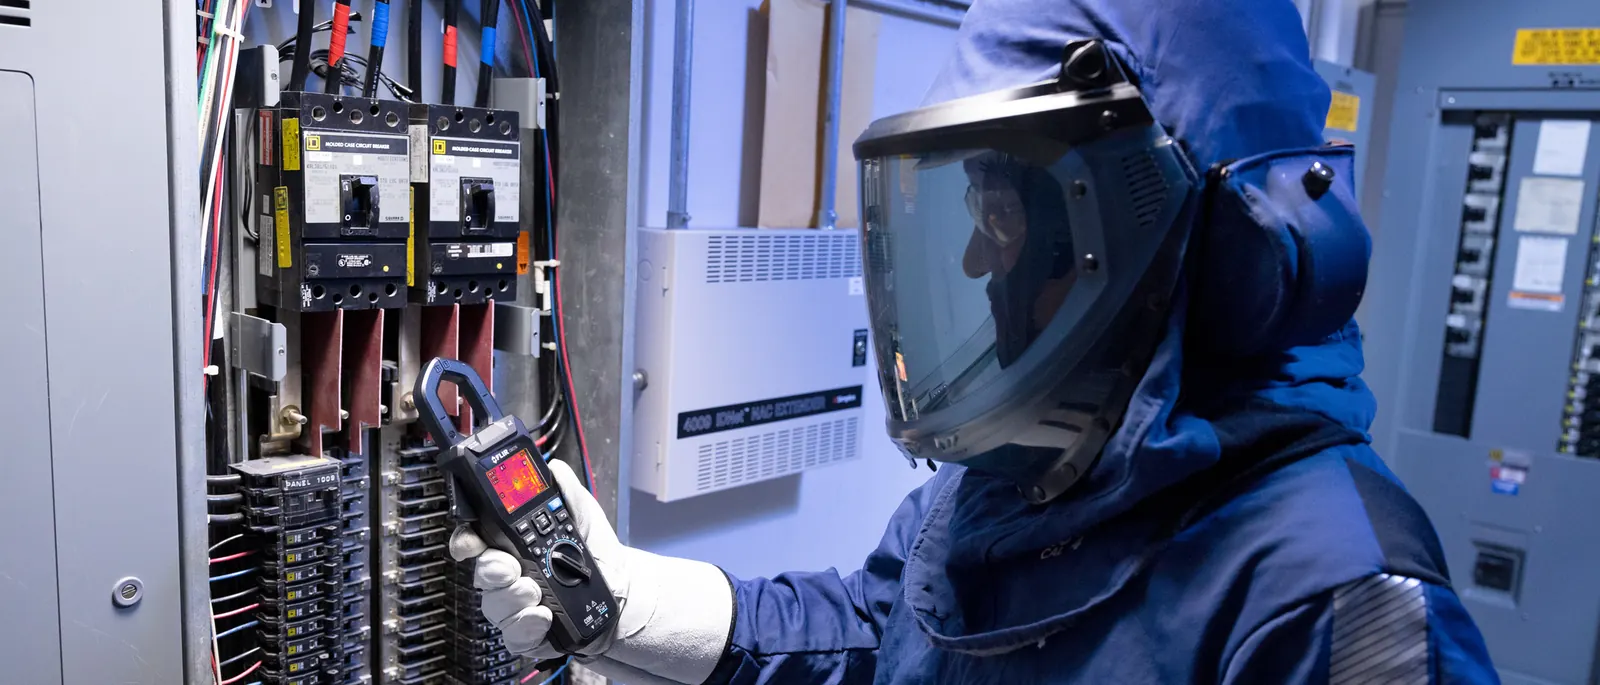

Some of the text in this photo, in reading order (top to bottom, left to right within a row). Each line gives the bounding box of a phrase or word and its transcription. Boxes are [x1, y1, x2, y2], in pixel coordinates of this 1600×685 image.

[751, 404, 773, 420] NAC
[774, 396, 825, 417] EXTENDER
[496, 449, 510, 461] FLIR
[285, 479, 311, 488] PANEL
[583, 614, 594, 625] COM
